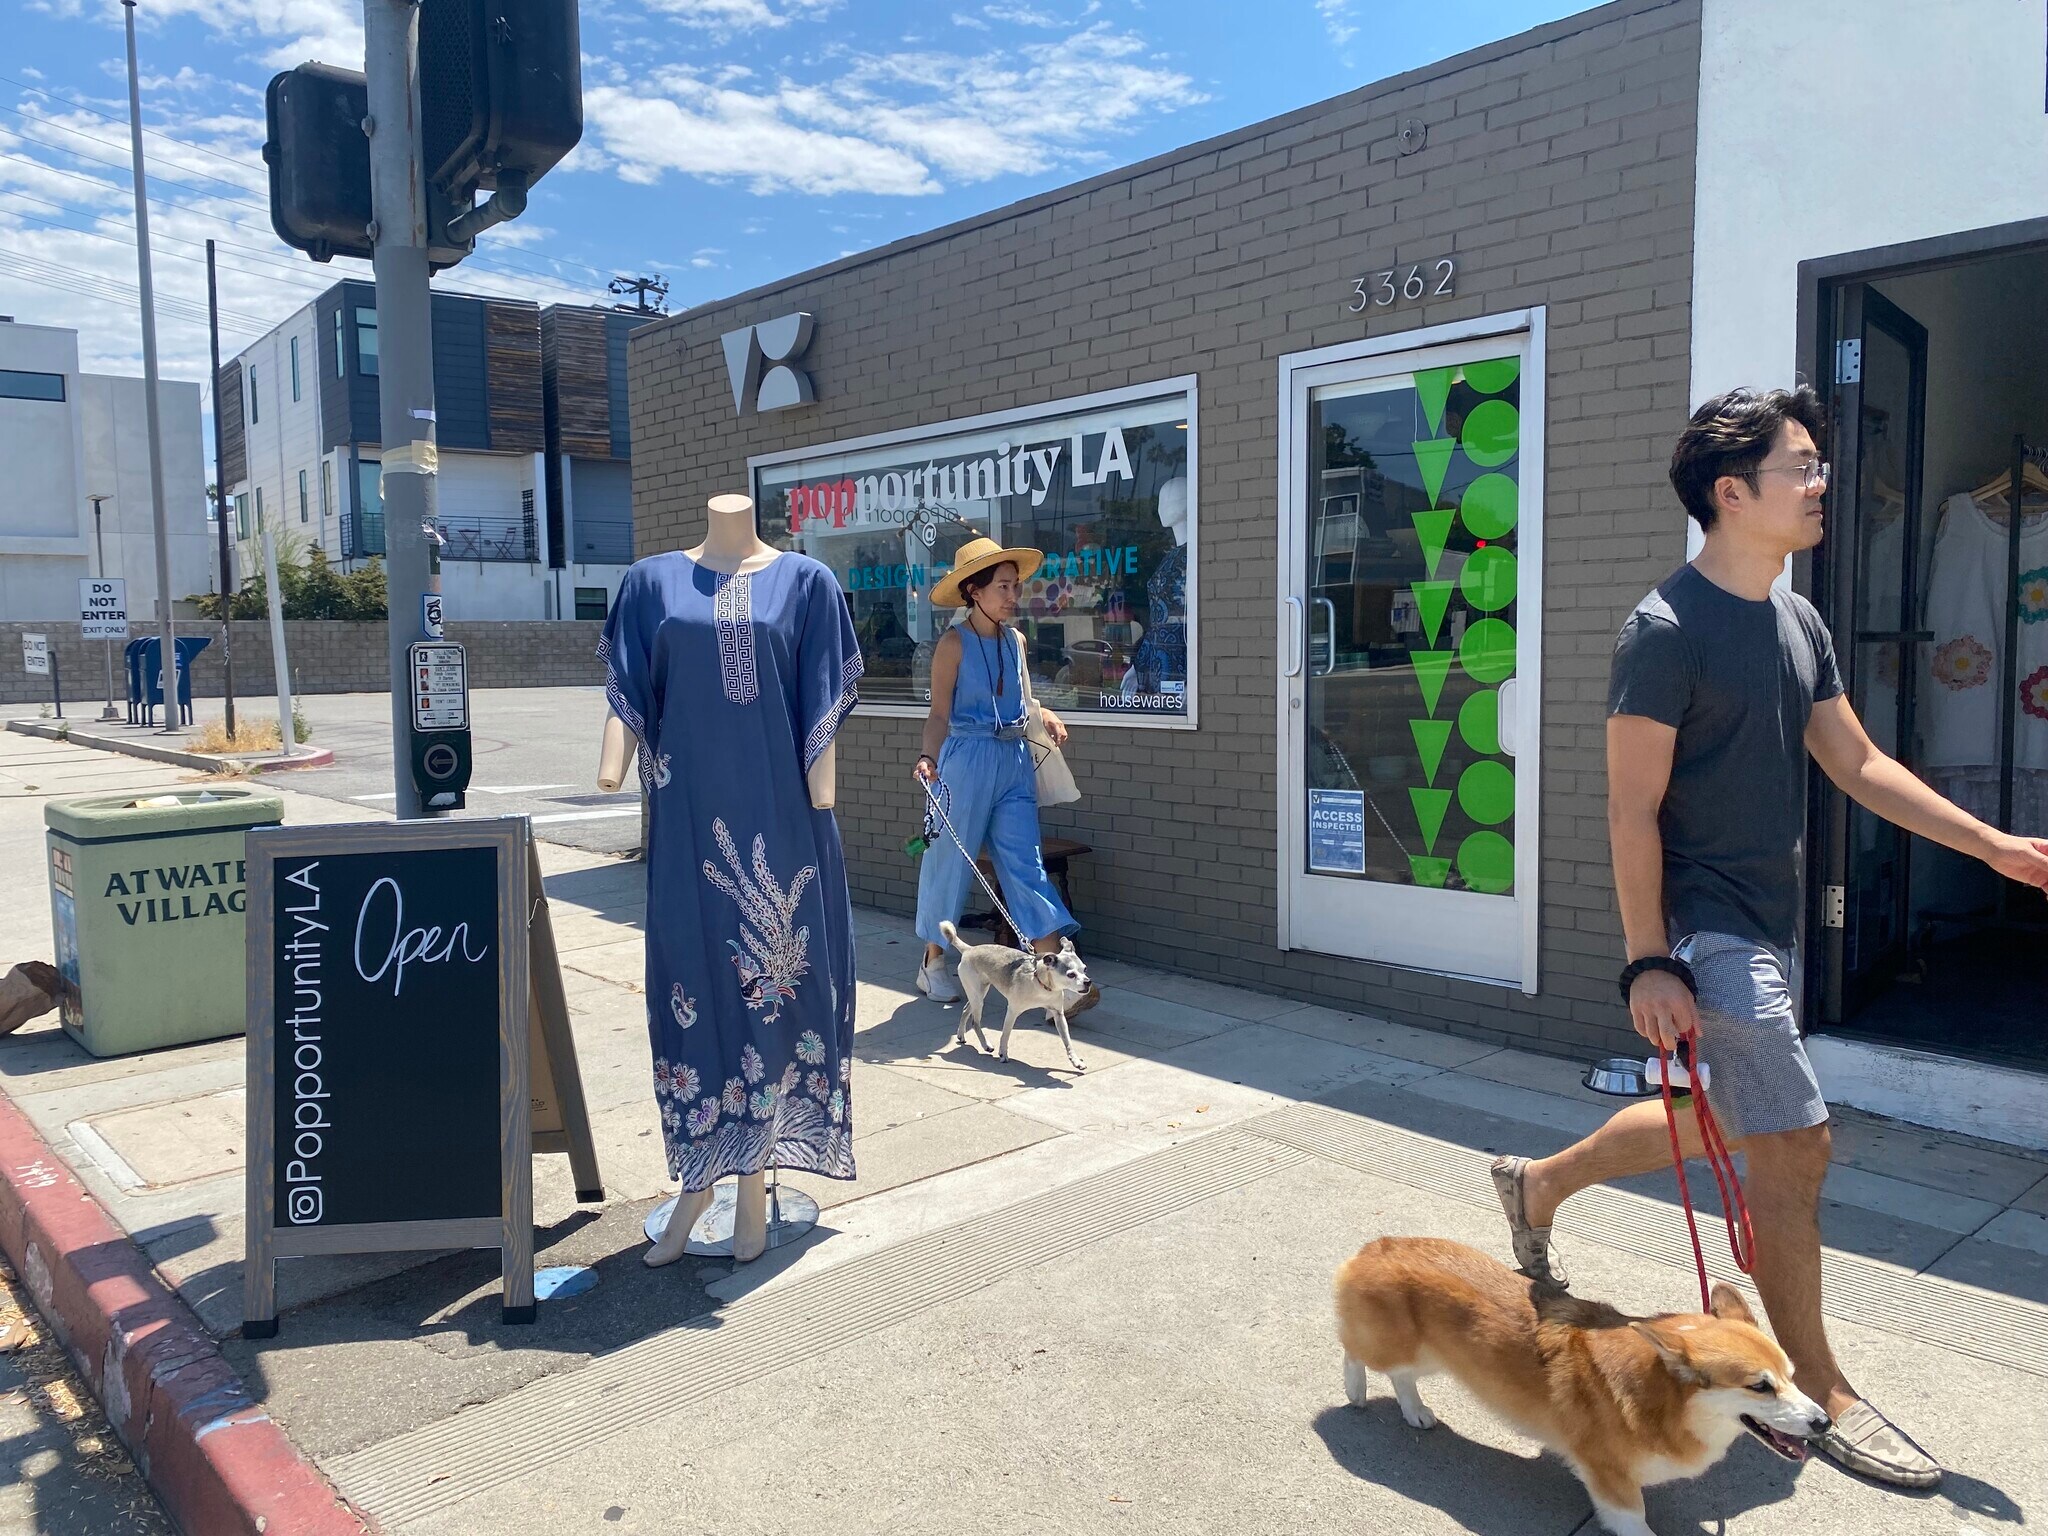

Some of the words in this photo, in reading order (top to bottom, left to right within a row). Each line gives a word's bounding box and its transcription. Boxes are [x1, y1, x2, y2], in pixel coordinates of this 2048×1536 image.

[1348, 259, 1454, 312] 3362
[789, 441, 1062, 533] popportunity
[1071, 426, 1134, 487] LA
[922, 522, 937, 547] @
[848, 563, 925, 590] DESIGN
[92, 584, 112, 593] DO
[89, 597, 117, 607] NOT
[82, 610, 126, 620] ENTER
[82, 626, 102, 634] EXIT
[104, 626, 126, 634] ONLY
[1099, 690, 1183, 708] housewares
[1312, 821, 1362, 832] INSPECTED
[1313, 810, 1362, 823] ACCESS
[117, 889, 246, 925] VILLAG
[354, 877, 488, 996] Open
[285, 861, 330, 1182] PopportunityLA
